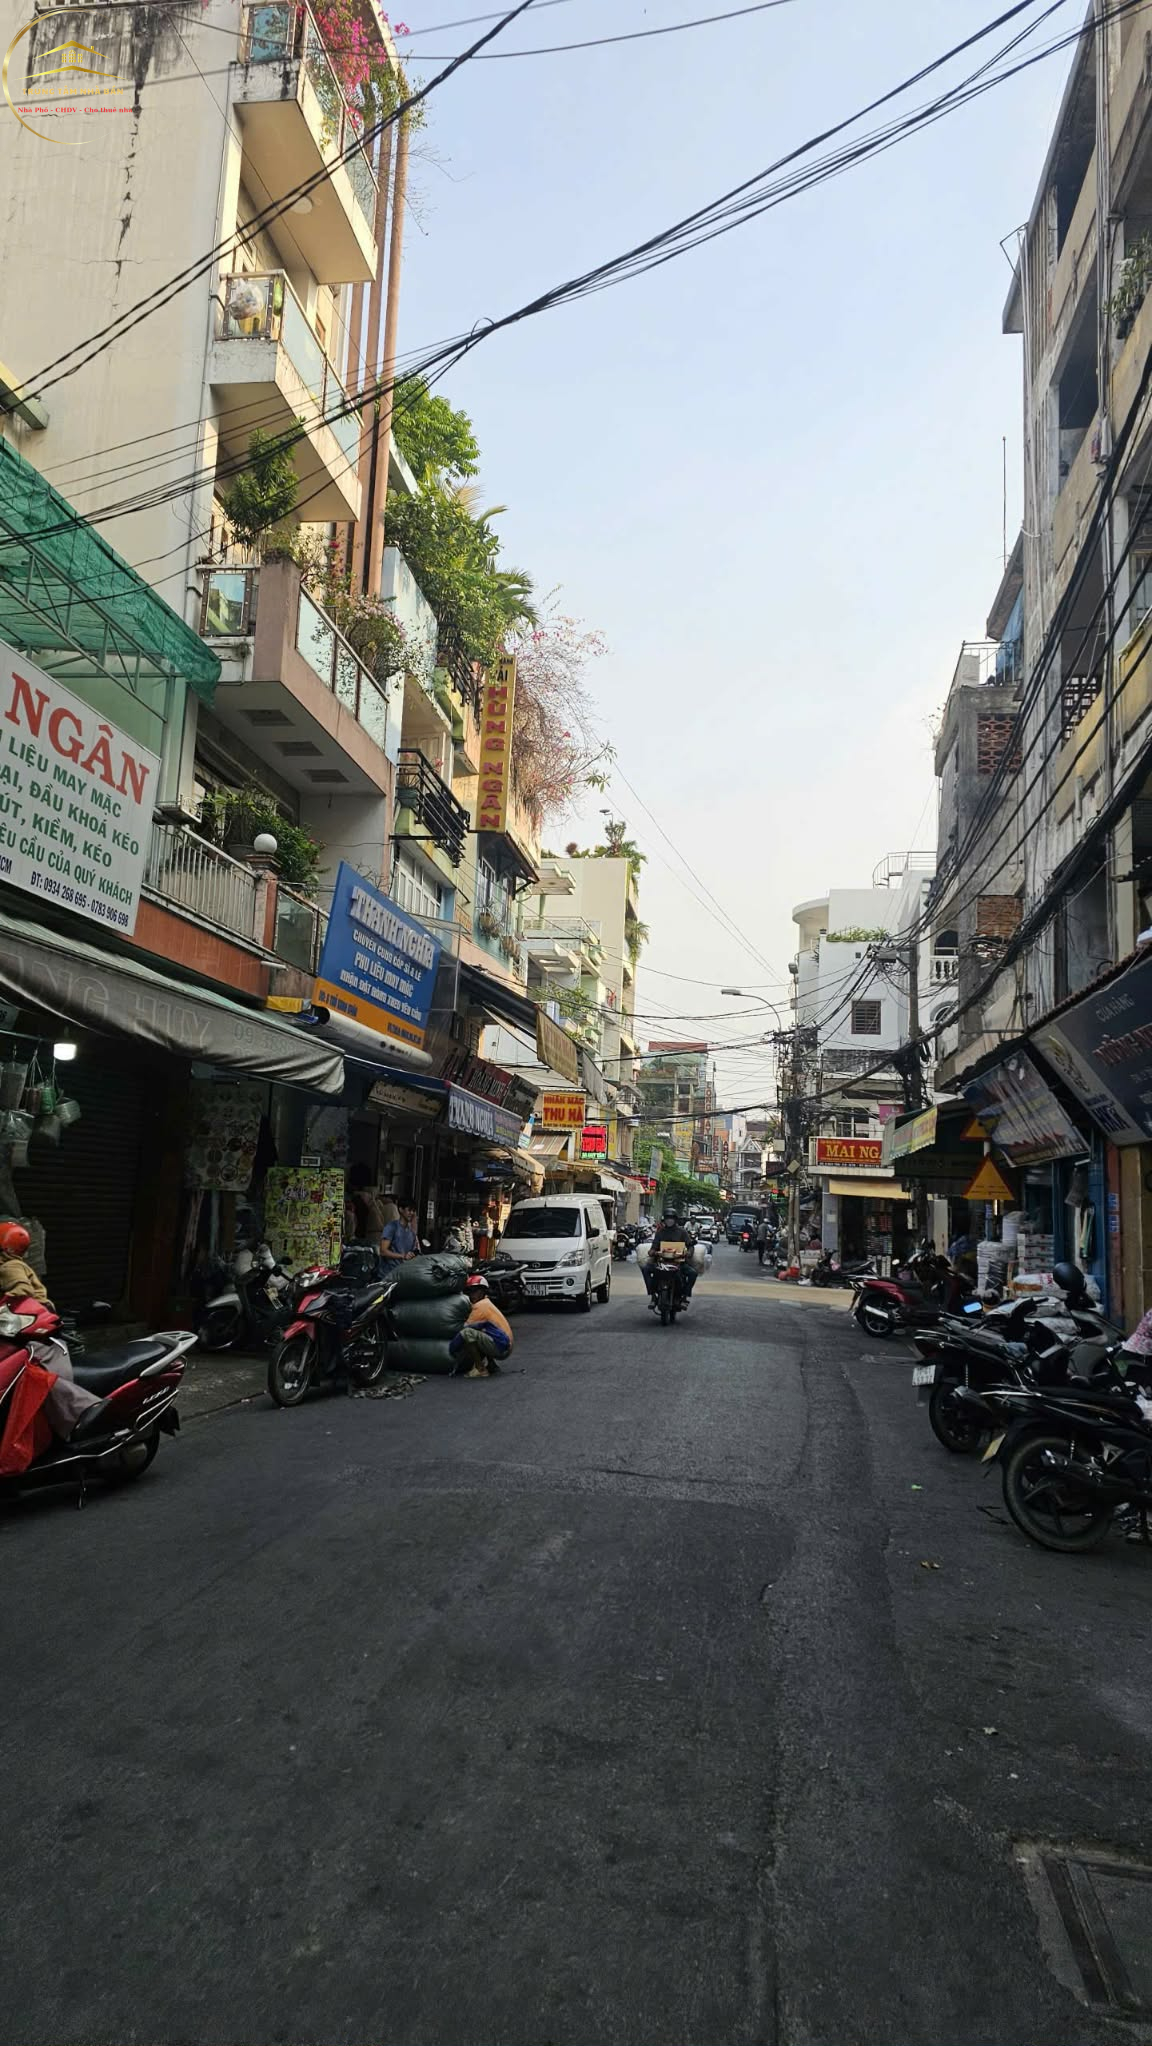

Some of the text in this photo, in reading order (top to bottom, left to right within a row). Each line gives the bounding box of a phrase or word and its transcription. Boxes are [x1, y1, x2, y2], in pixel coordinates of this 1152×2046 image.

[4, 672, 150, 805] NGÂN
[8, 736, 122, 818] LIỆU MAY MẶC
[0, 762, 139, 855] ẠI, ĐẦU KHOÁ KÉO
[32, 813, 77, 853] KIỀM,
[82, 840, 112, 867] KÉO
[19, 835, 45, 862] CẦU
[47, 850, 71, 876] CỦA
[74, 865, 96, 887] QUÝ
[98, 877, 133, 906] KHÁCH
[30, 871, 43, 889] ĐT:
[43, 877, 60, 897] 0934
[61, 885, 74, 902] 268
[74, 892, 87, 909] 695
[91, 900, 106, 919] 0783
[106, 906, 118, 922] 906
[118, 911, 129, 927] 698
[354, 952, 369, 975] PHỤ
[544, 1105, 584, 1122] THU HÀ
[826, 1144, 882, 1159] MAI NG
